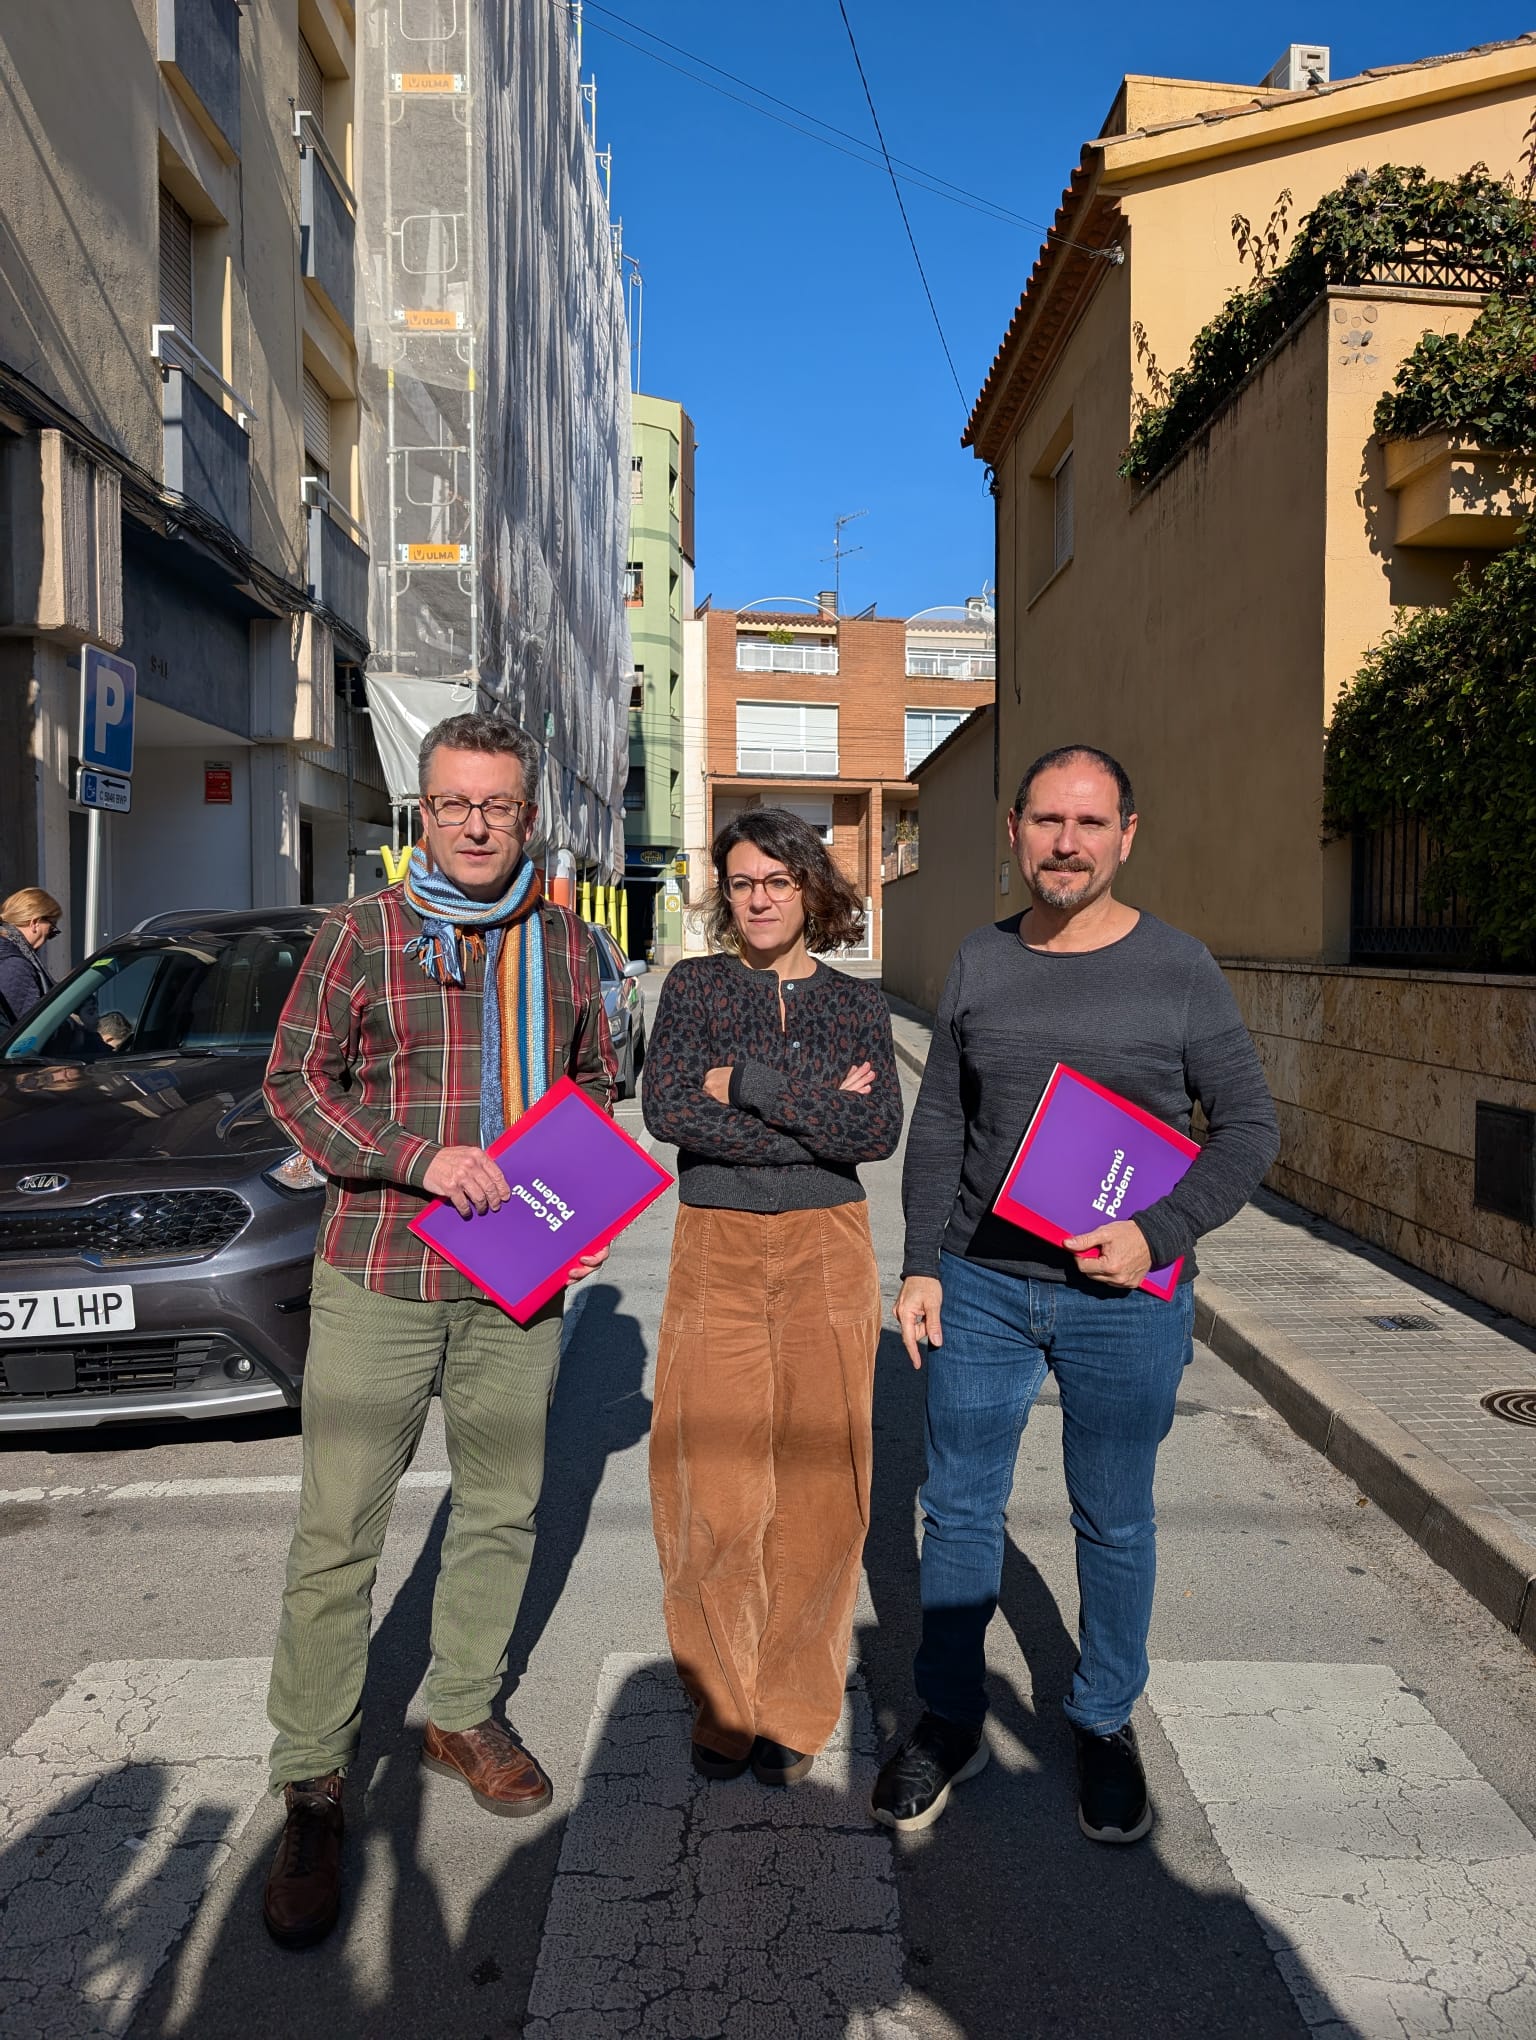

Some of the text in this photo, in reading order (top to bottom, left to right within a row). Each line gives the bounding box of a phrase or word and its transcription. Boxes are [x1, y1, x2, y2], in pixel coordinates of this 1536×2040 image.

[421, 80, 449, 89] ULMA
[422, 318, 450, 326] ULMA
[426, 551, 454, 560] ULMA
[94, 664, 125, 754] P
[24, 1175, 59, 1189] KIA
[532, 1178, 575, 1221] Podem
[1092, 1148, 1125, 1212] En Comú
[1105, 1165, 1135, 1218] Podem
[511, 1184, 563, 1232] En Comú
[0, 1292, 123, 1331] 57 LHP
